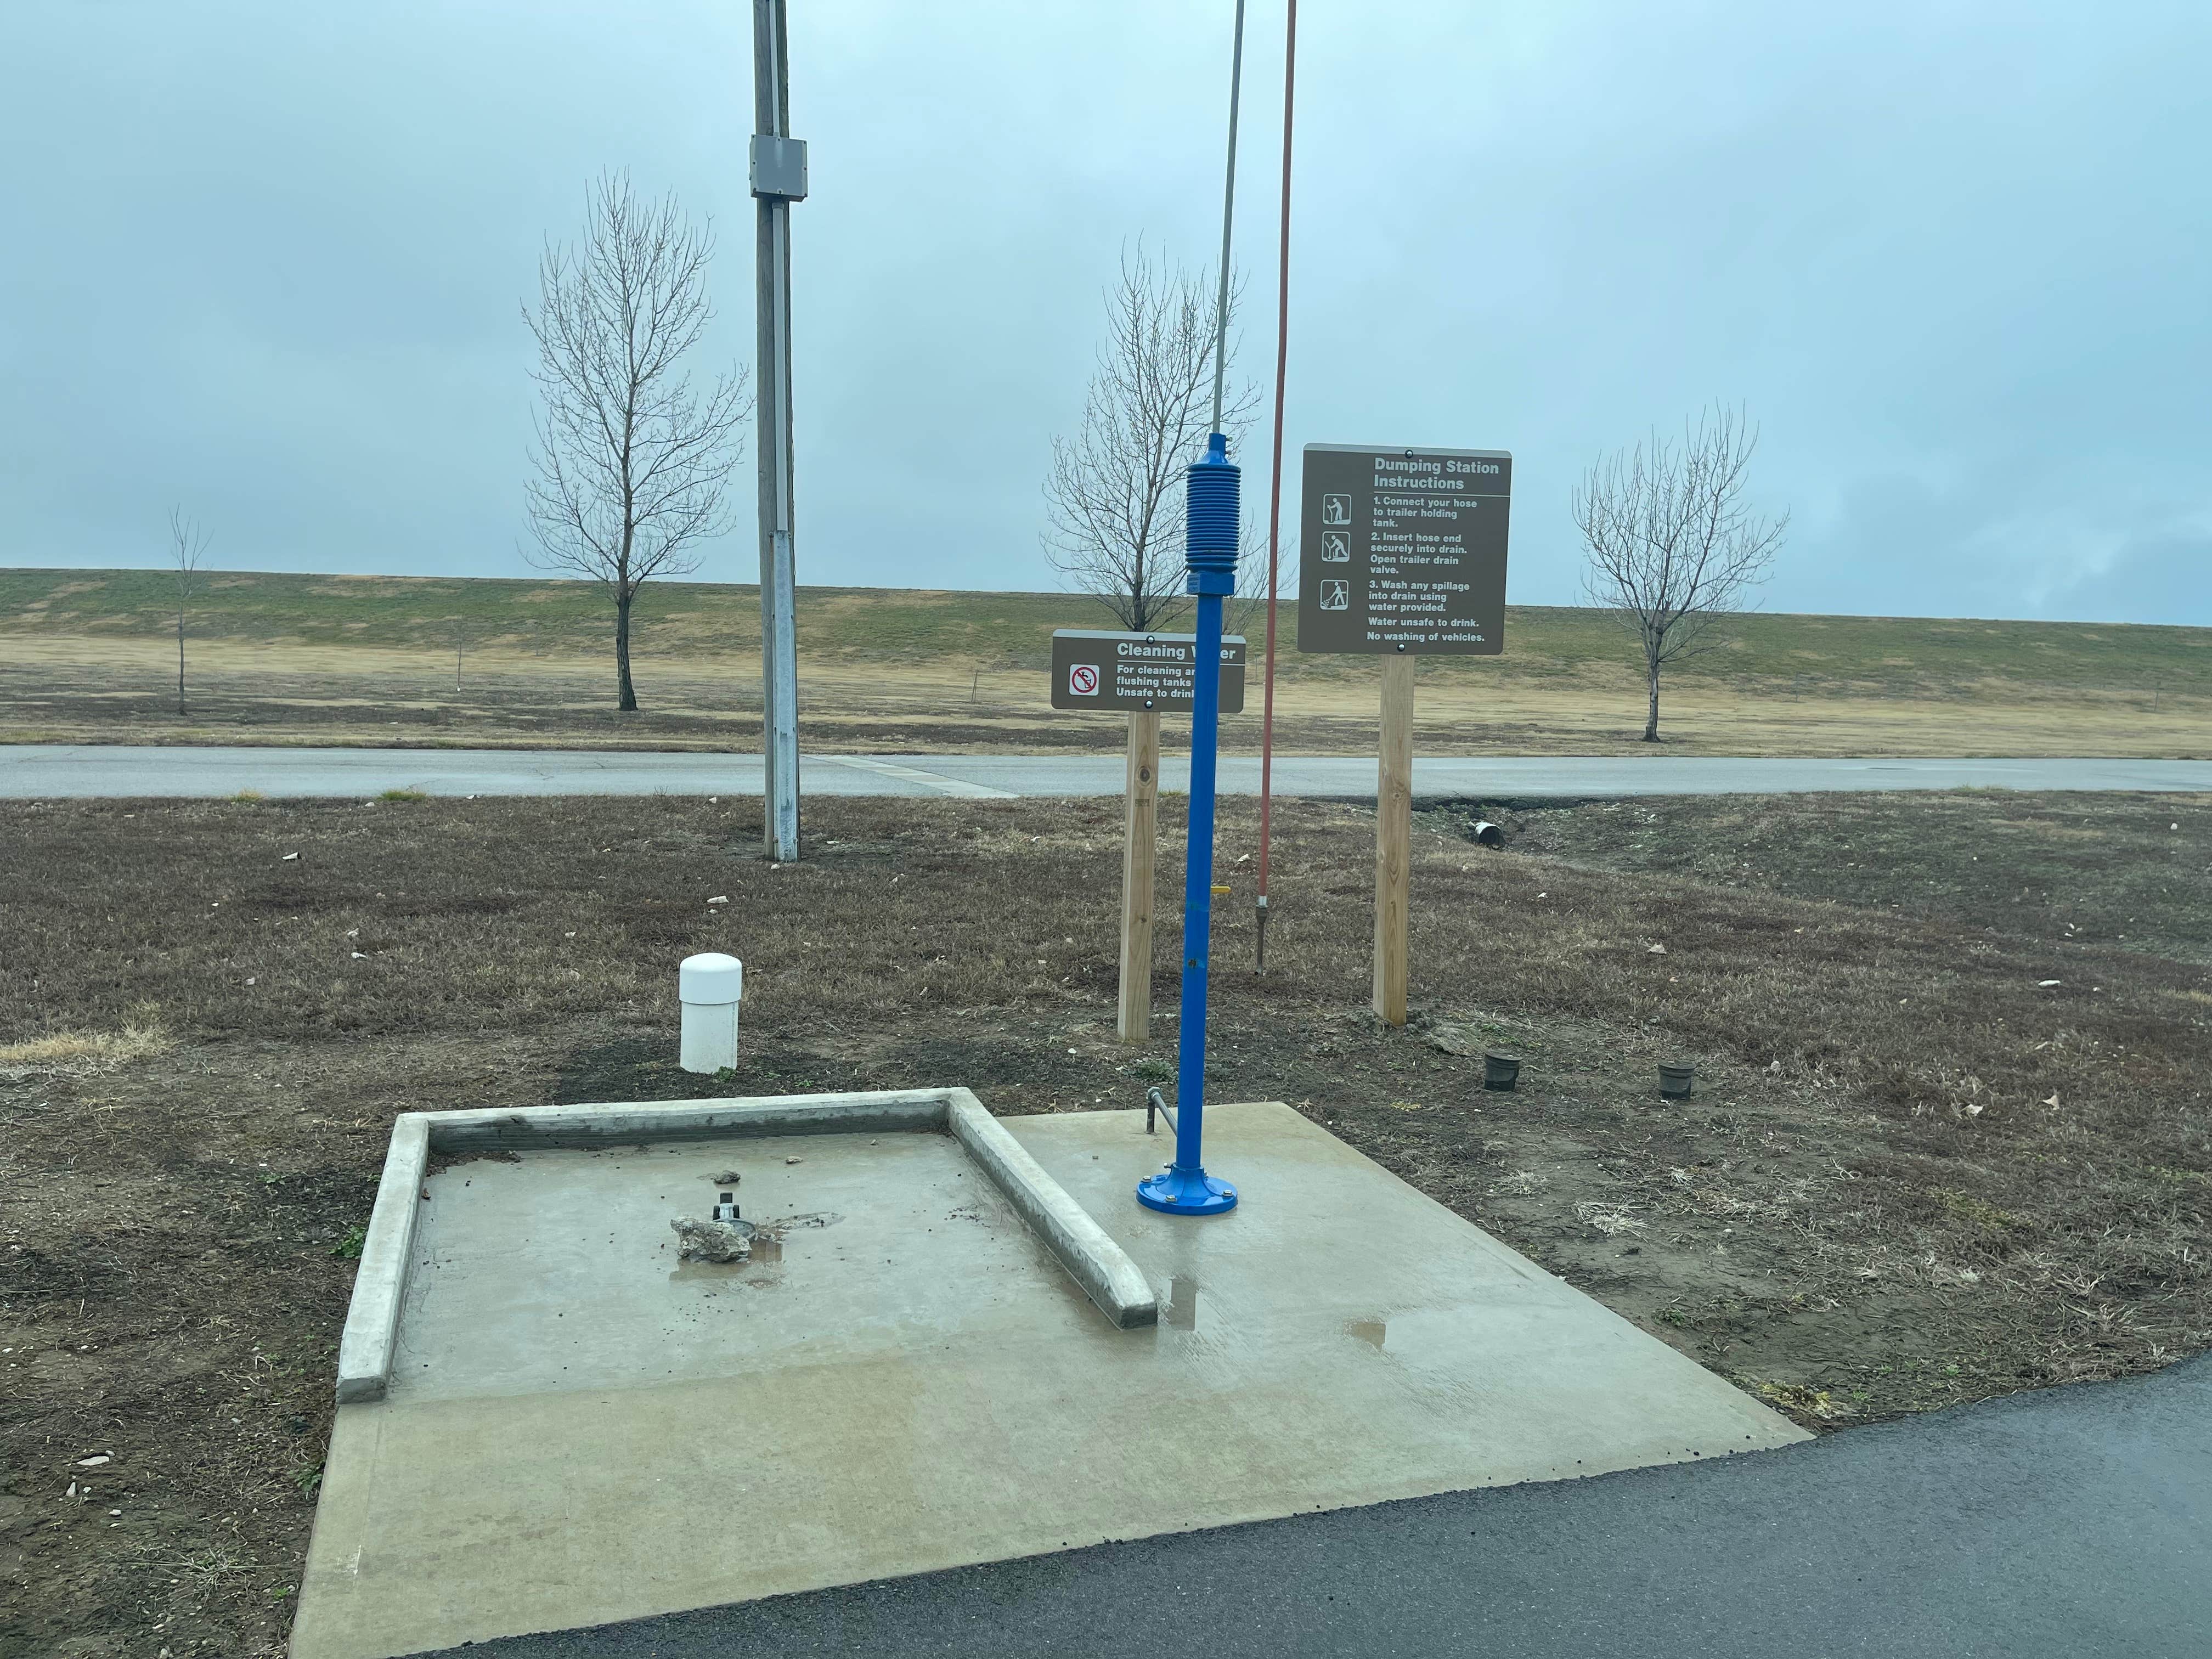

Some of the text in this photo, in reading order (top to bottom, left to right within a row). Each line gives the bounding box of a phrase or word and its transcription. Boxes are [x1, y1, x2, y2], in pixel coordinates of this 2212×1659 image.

[1375, 458, 1499, 474] Dumping Station
[1374, 475, 1464, 489] Instructions
[1373, 496, 1477, 508] 1. Connect your hose
[1386, 509, 1418, 517] trailer
[1420, 509, 1458, 520] holding
[1373, 519, 1398, 527] tank.
[1383, 533, 1412, 541] Insert
[1416, 533, 1440, 542] hose
[1443, 534, 1462, 543] end
[1370, 544, 1468, 554] securely into drain.
[1370, 555, 1459, 565] Open trailer drain
[1370, 565, 1399, 574] valve.
[1369, 580, 1470, 591] 3. Wash any spillage
[1391, 592, 1417, 600] drain
[1420, 593, 1447, 602] using
[1400, 603, 1446, 613] provided.
[1368, 617, 1479, 627] Water unsafe to drink.
[1367, 631, 1485, 642] No washing of vehicles.
[1117, 642, 1186, 661] Cleaning
[1117, 665, 1135, 674] For
[1137, 666, 1182, 676] cleaning
[1116, 676, 1191, 687] flushing tanks
[1116, 687, 1153, 697] Unsafe
[1156, 689, 1167, 697] to
